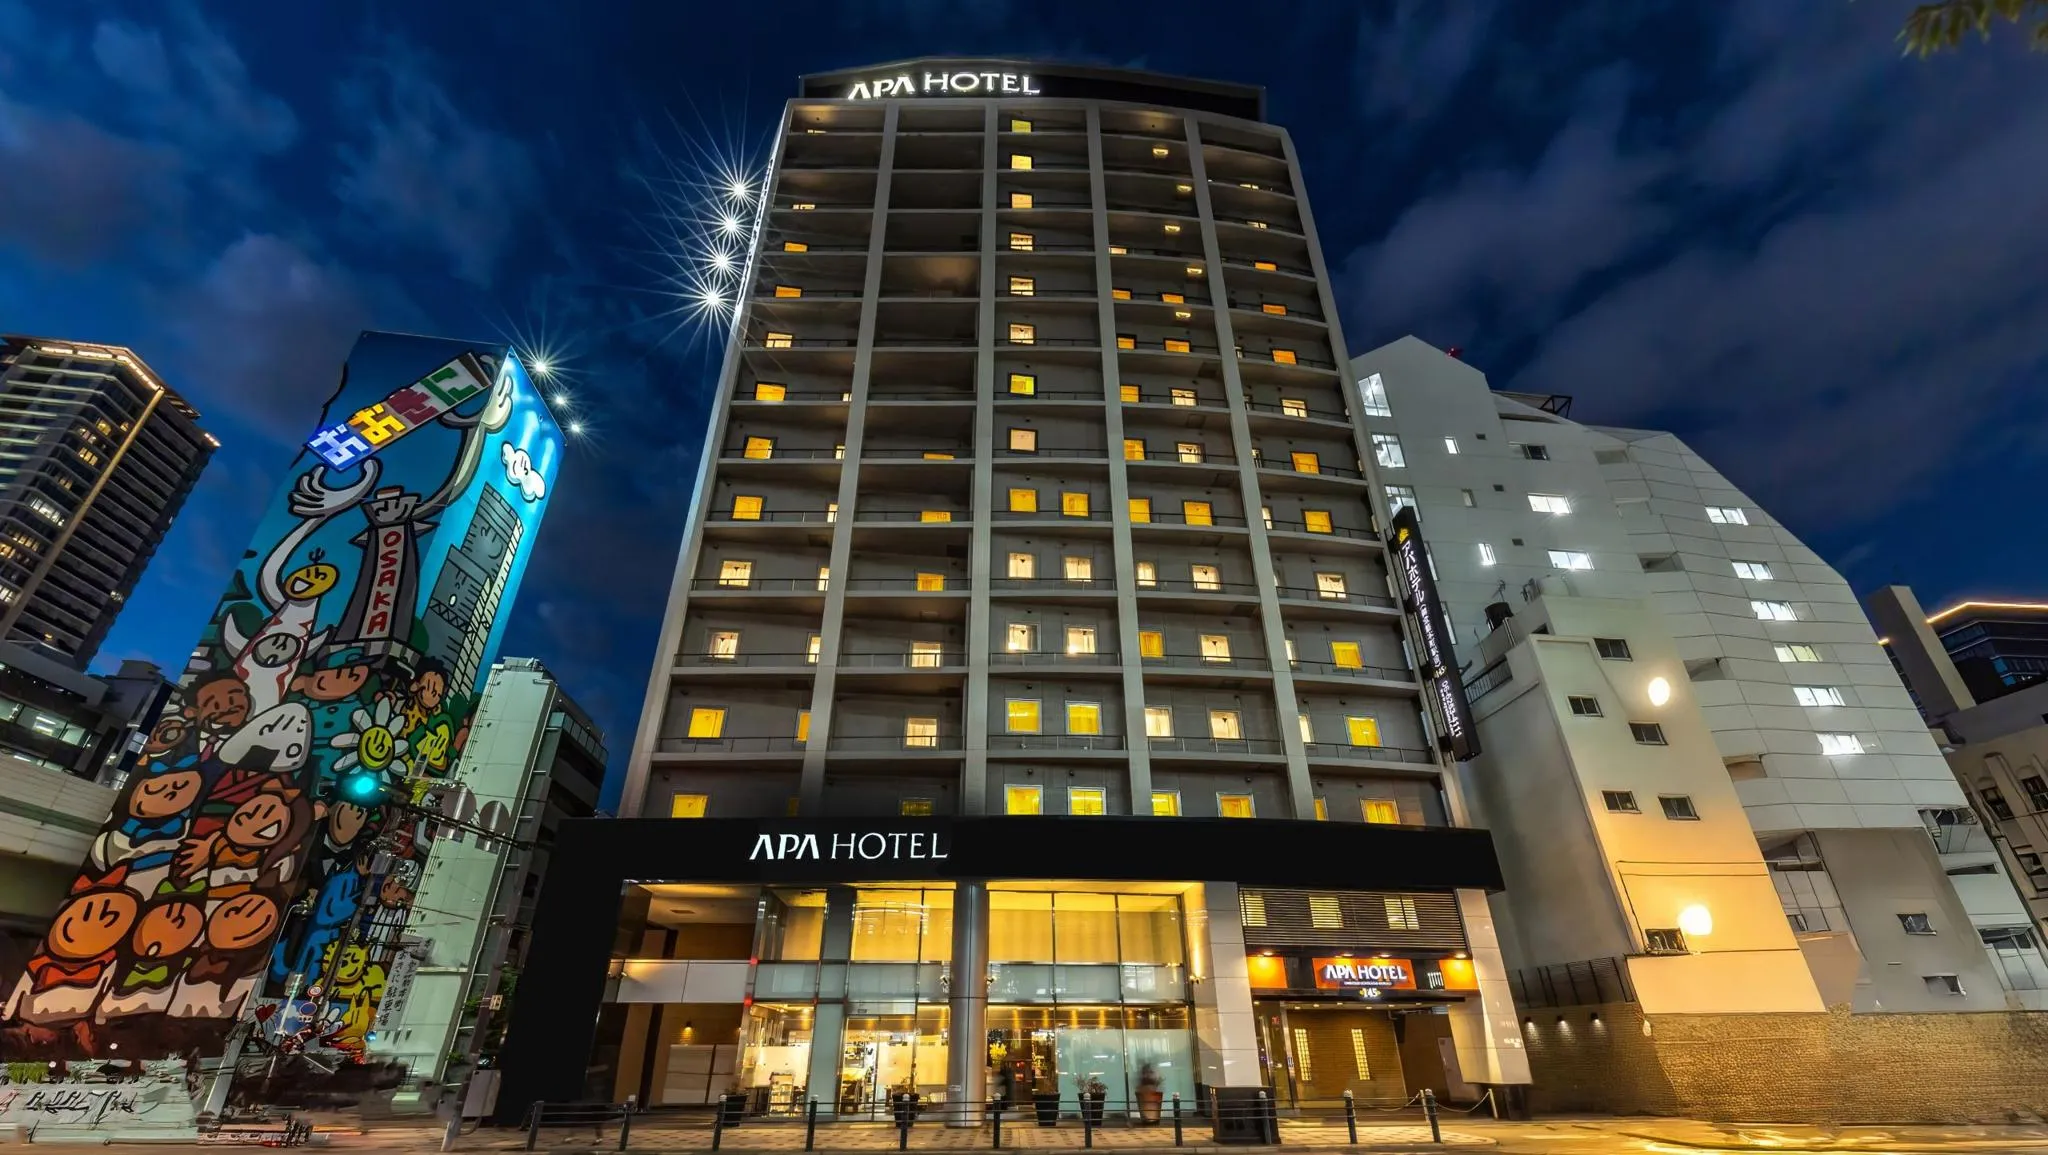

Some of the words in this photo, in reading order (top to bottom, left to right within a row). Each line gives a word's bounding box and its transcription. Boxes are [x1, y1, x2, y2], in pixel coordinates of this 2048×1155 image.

[848, 75, 916, 100] APA
[924, 72, 1041, 96] HOTEL
[367, 531, 402, 635] OSAKA
[749, 833, 820, 860] APA
[831, 832, 948, 860] HOTEL
[1326, 964, 1357, 980] APA
[1358, 964, 1408, 980] HOTEL
